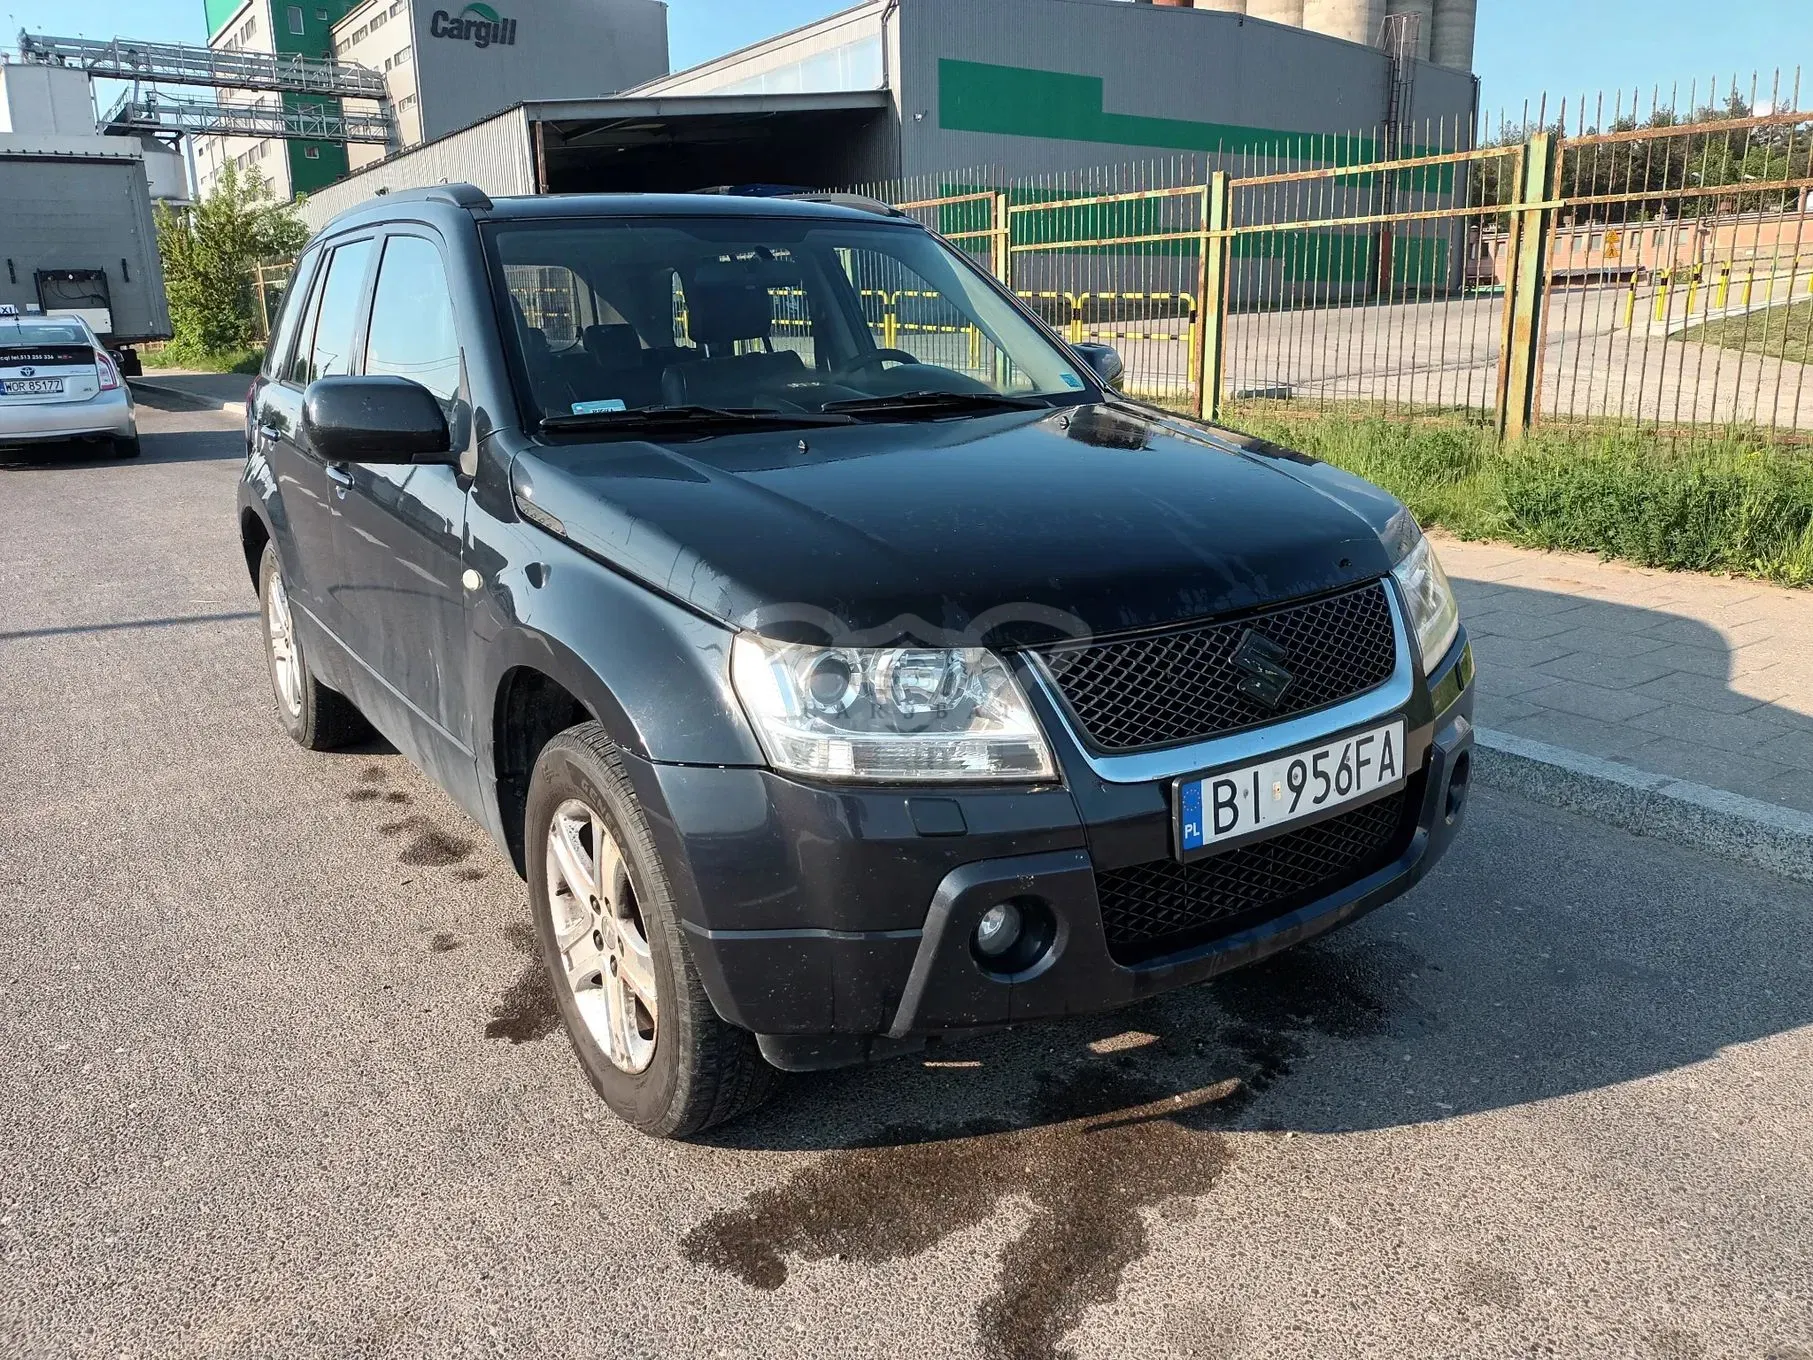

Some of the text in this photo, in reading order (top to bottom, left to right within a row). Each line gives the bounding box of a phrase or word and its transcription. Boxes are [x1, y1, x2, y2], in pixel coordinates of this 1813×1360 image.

[430, 9, 517, 49] Cargill
[1212, 730, 1396, 836] BI 956FA
[1184, 822, 1200, 839] PL
